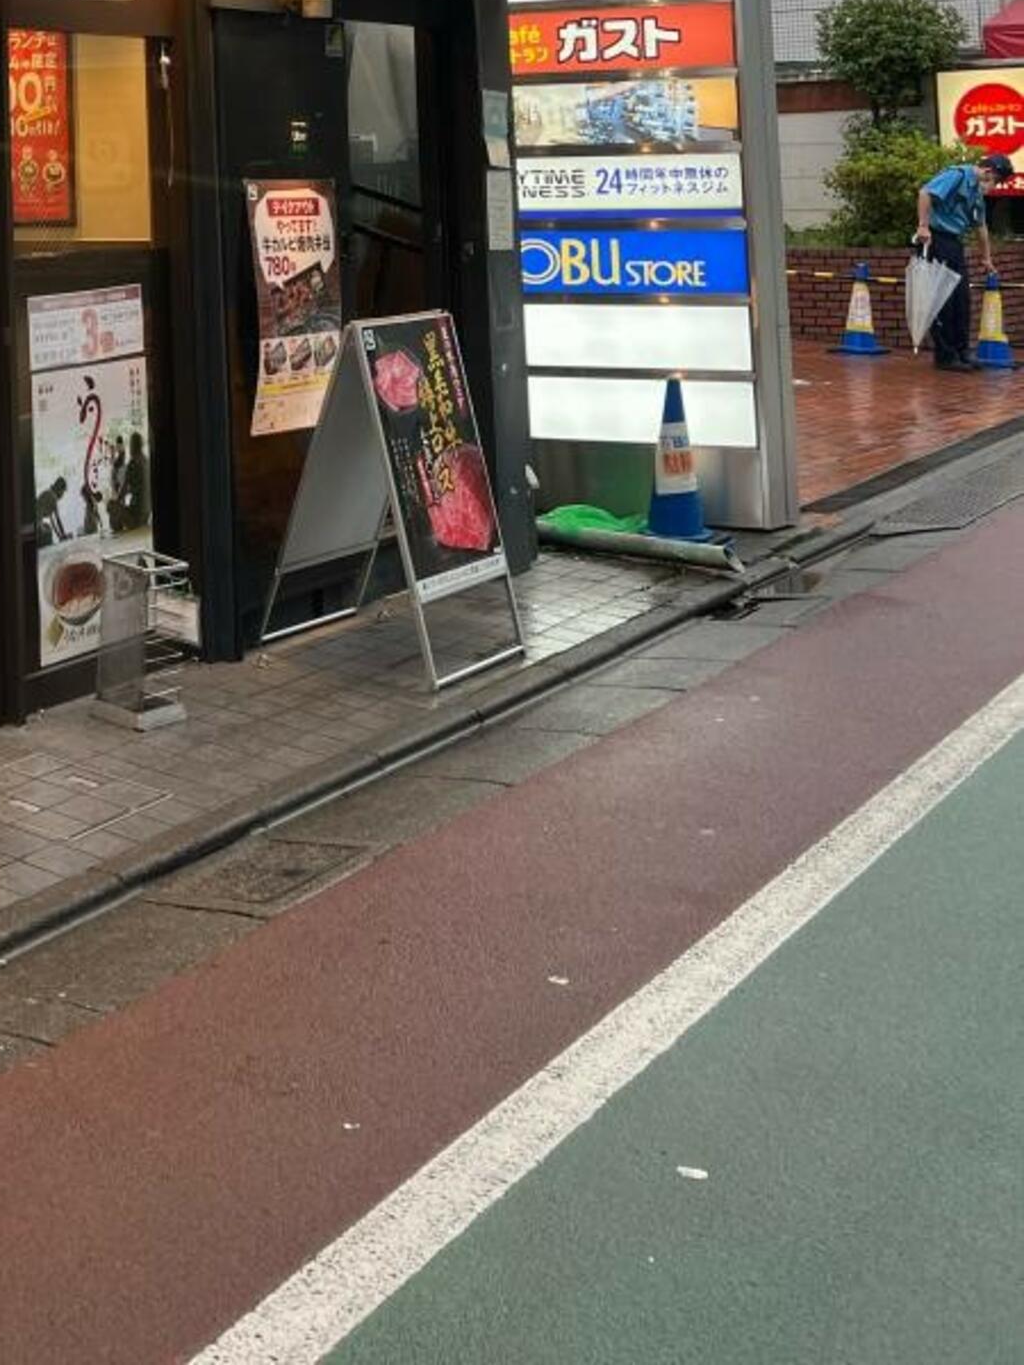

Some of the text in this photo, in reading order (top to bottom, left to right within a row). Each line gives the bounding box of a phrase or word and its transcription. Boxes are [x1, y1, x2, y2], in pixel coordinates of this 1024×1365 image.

[558, 17, 681, 63] ガスト
[966, 115, 1024, 137] ガスト
[521, 186, 585, 199] NESS
[595, 168, 622, 195] 24
[625, 260, 706, 287] STORE
